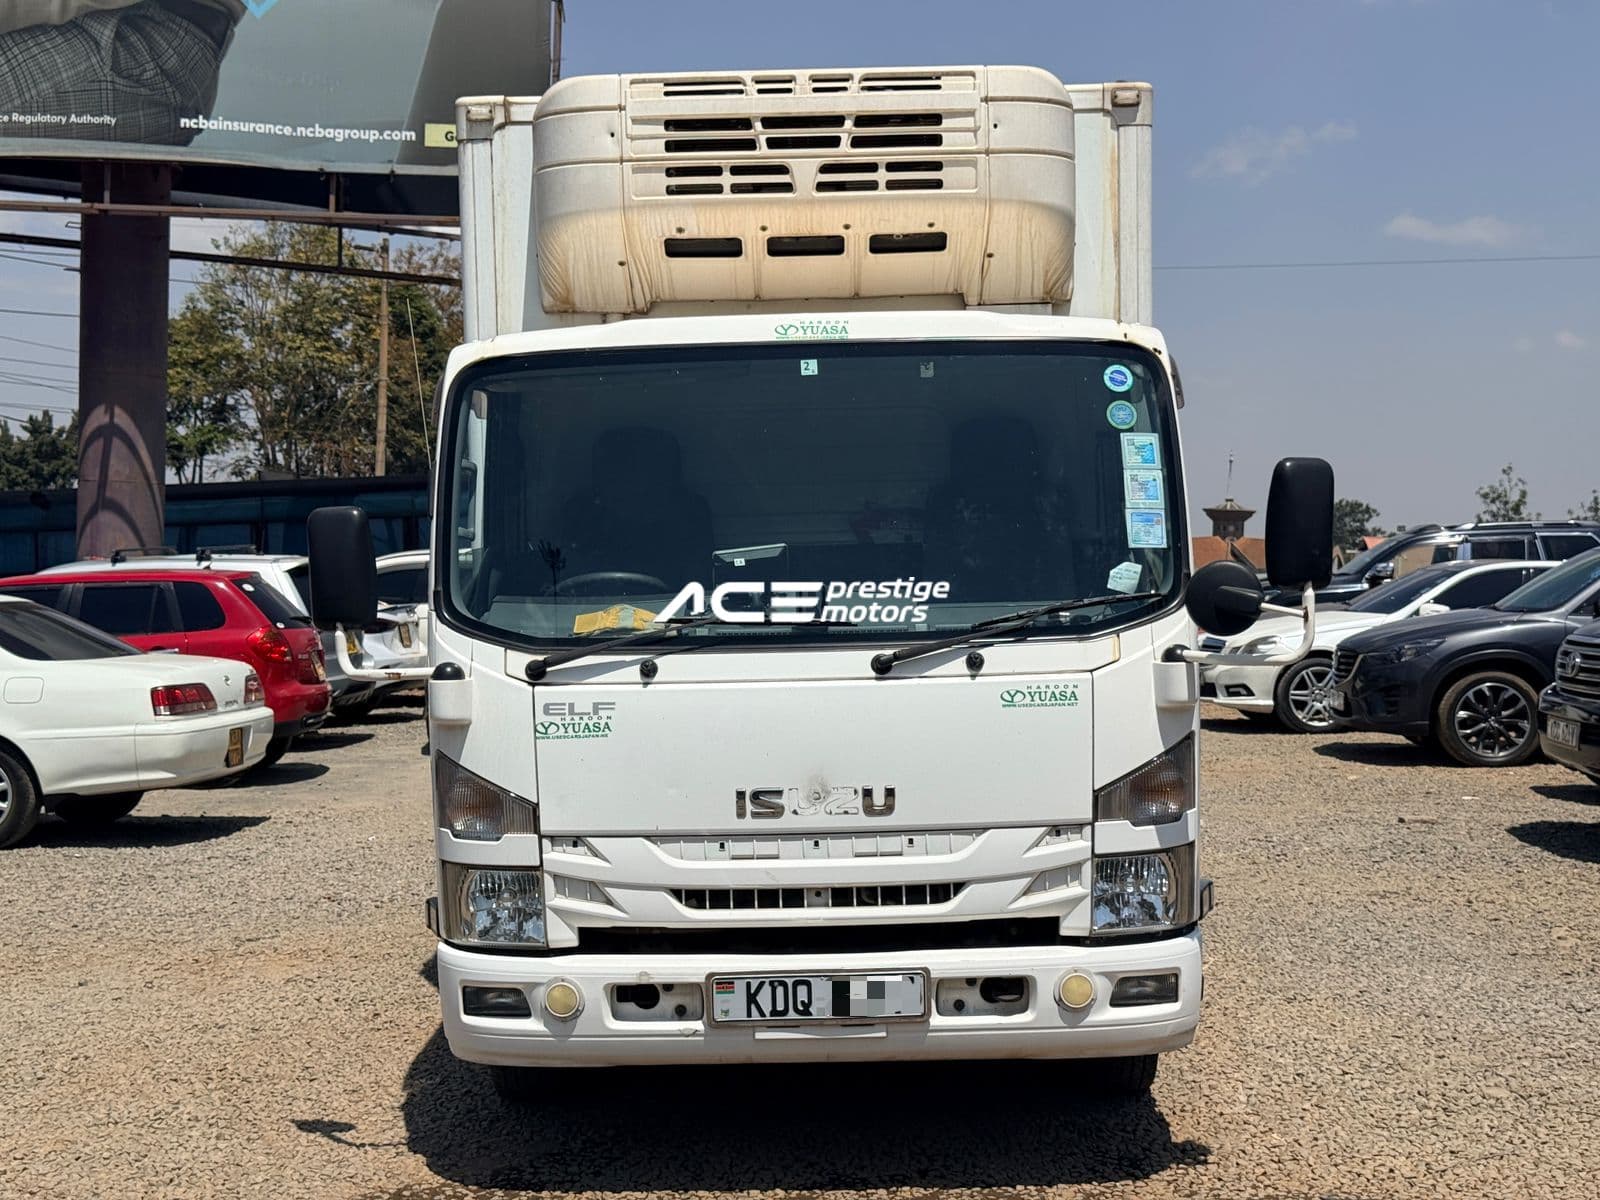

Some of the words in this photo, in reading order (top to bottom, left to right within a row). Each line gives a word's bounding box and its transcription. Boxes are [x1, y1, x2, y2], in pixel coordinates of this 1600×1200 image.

[12, 112, 66, 126] Regulatory
[69, 114, 117, 126] Authority
[179, 114, 417, 143] ncbainsurance.ncbagroup.com
[444, 130, 457, 142] G
[800, 325, 849, 335] YUASA
[1027, 690, 1079, 702] YUASA
[543, 702, 616, 716] ELF
[560, 722, 612, 733] YUASA
[735, 785, 896, 820] ISUZU
[745, 979, 813, 1018] KDQ
